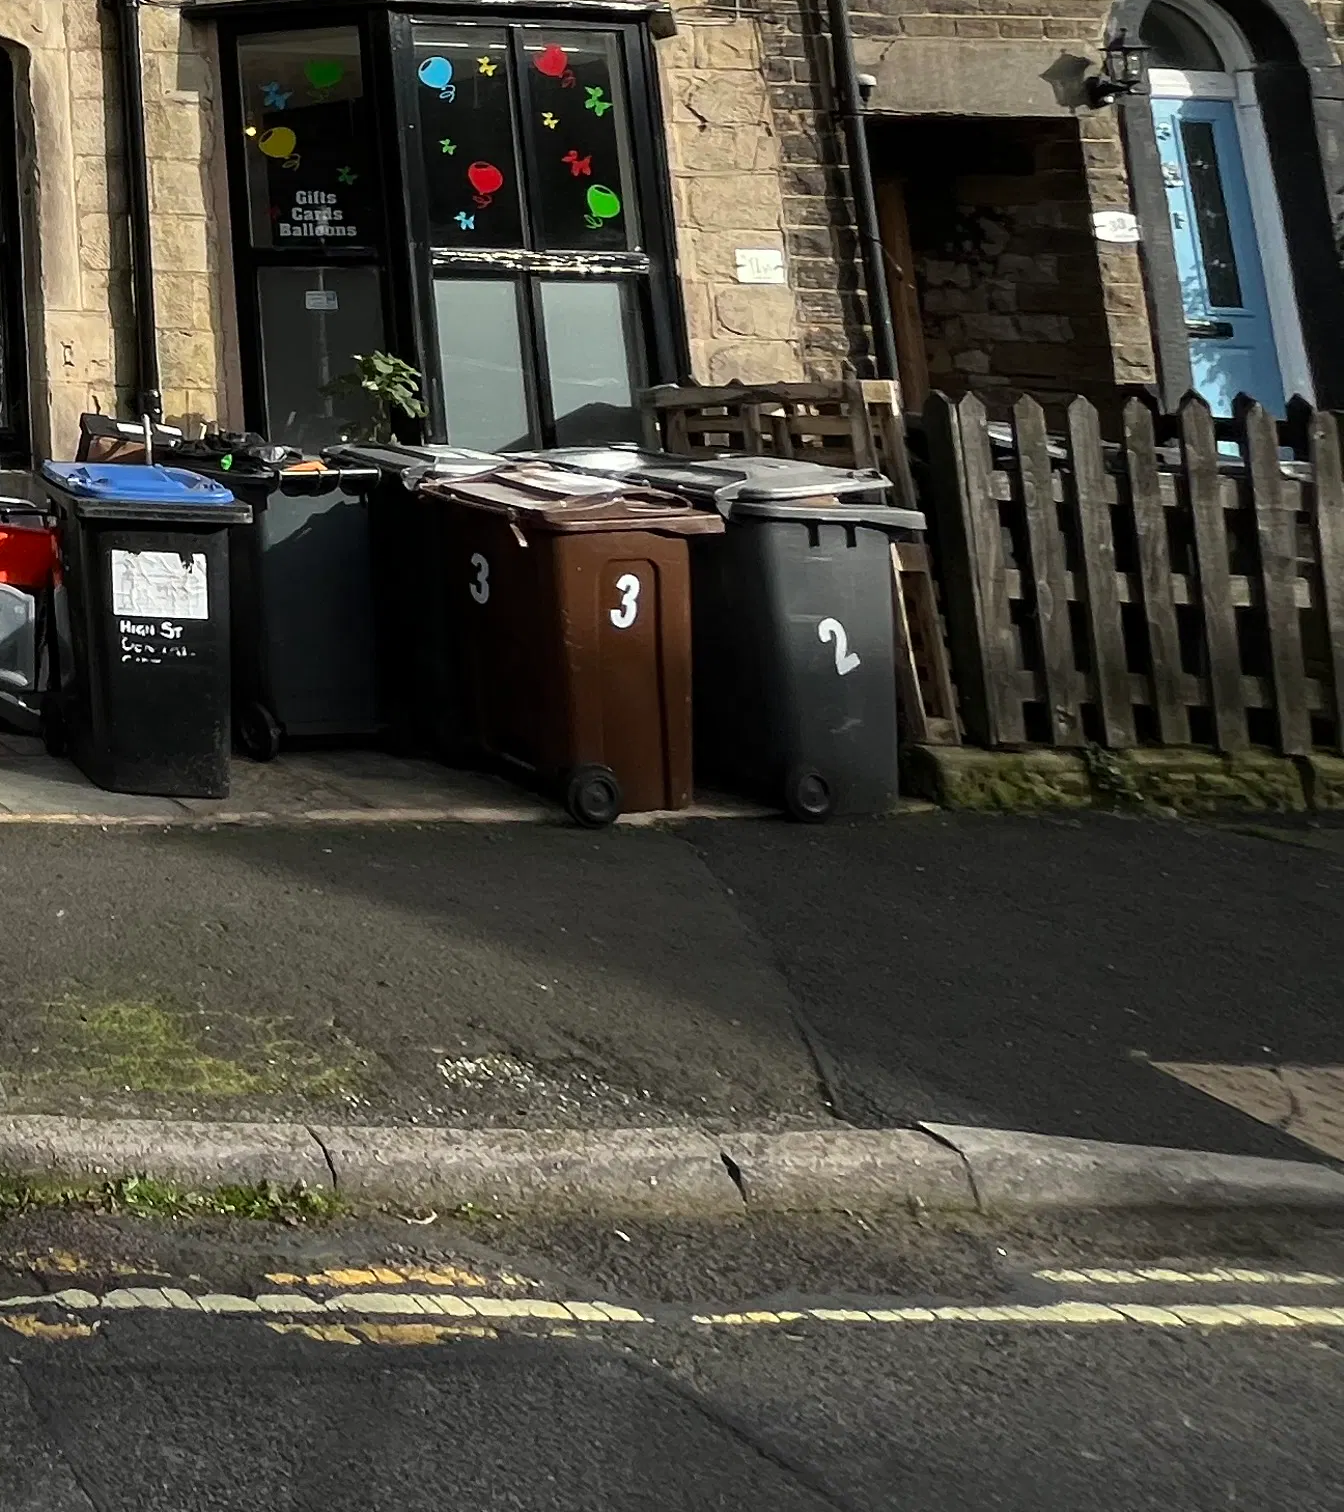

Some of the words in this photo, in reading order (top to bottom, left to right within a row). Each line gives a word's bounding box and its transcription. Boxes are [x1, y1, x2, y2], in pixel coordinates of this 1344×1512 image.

[295, 191, 337, 205] Gifts
[291, 207, 343, 221] Cards
[279, 223, 357, 237] Balloons
[469, 553, 489, 604] 3
[610, 573, 641, 628] 3
[160, 620, 183, 639] ST
[817, 617, 861, 676] 2
